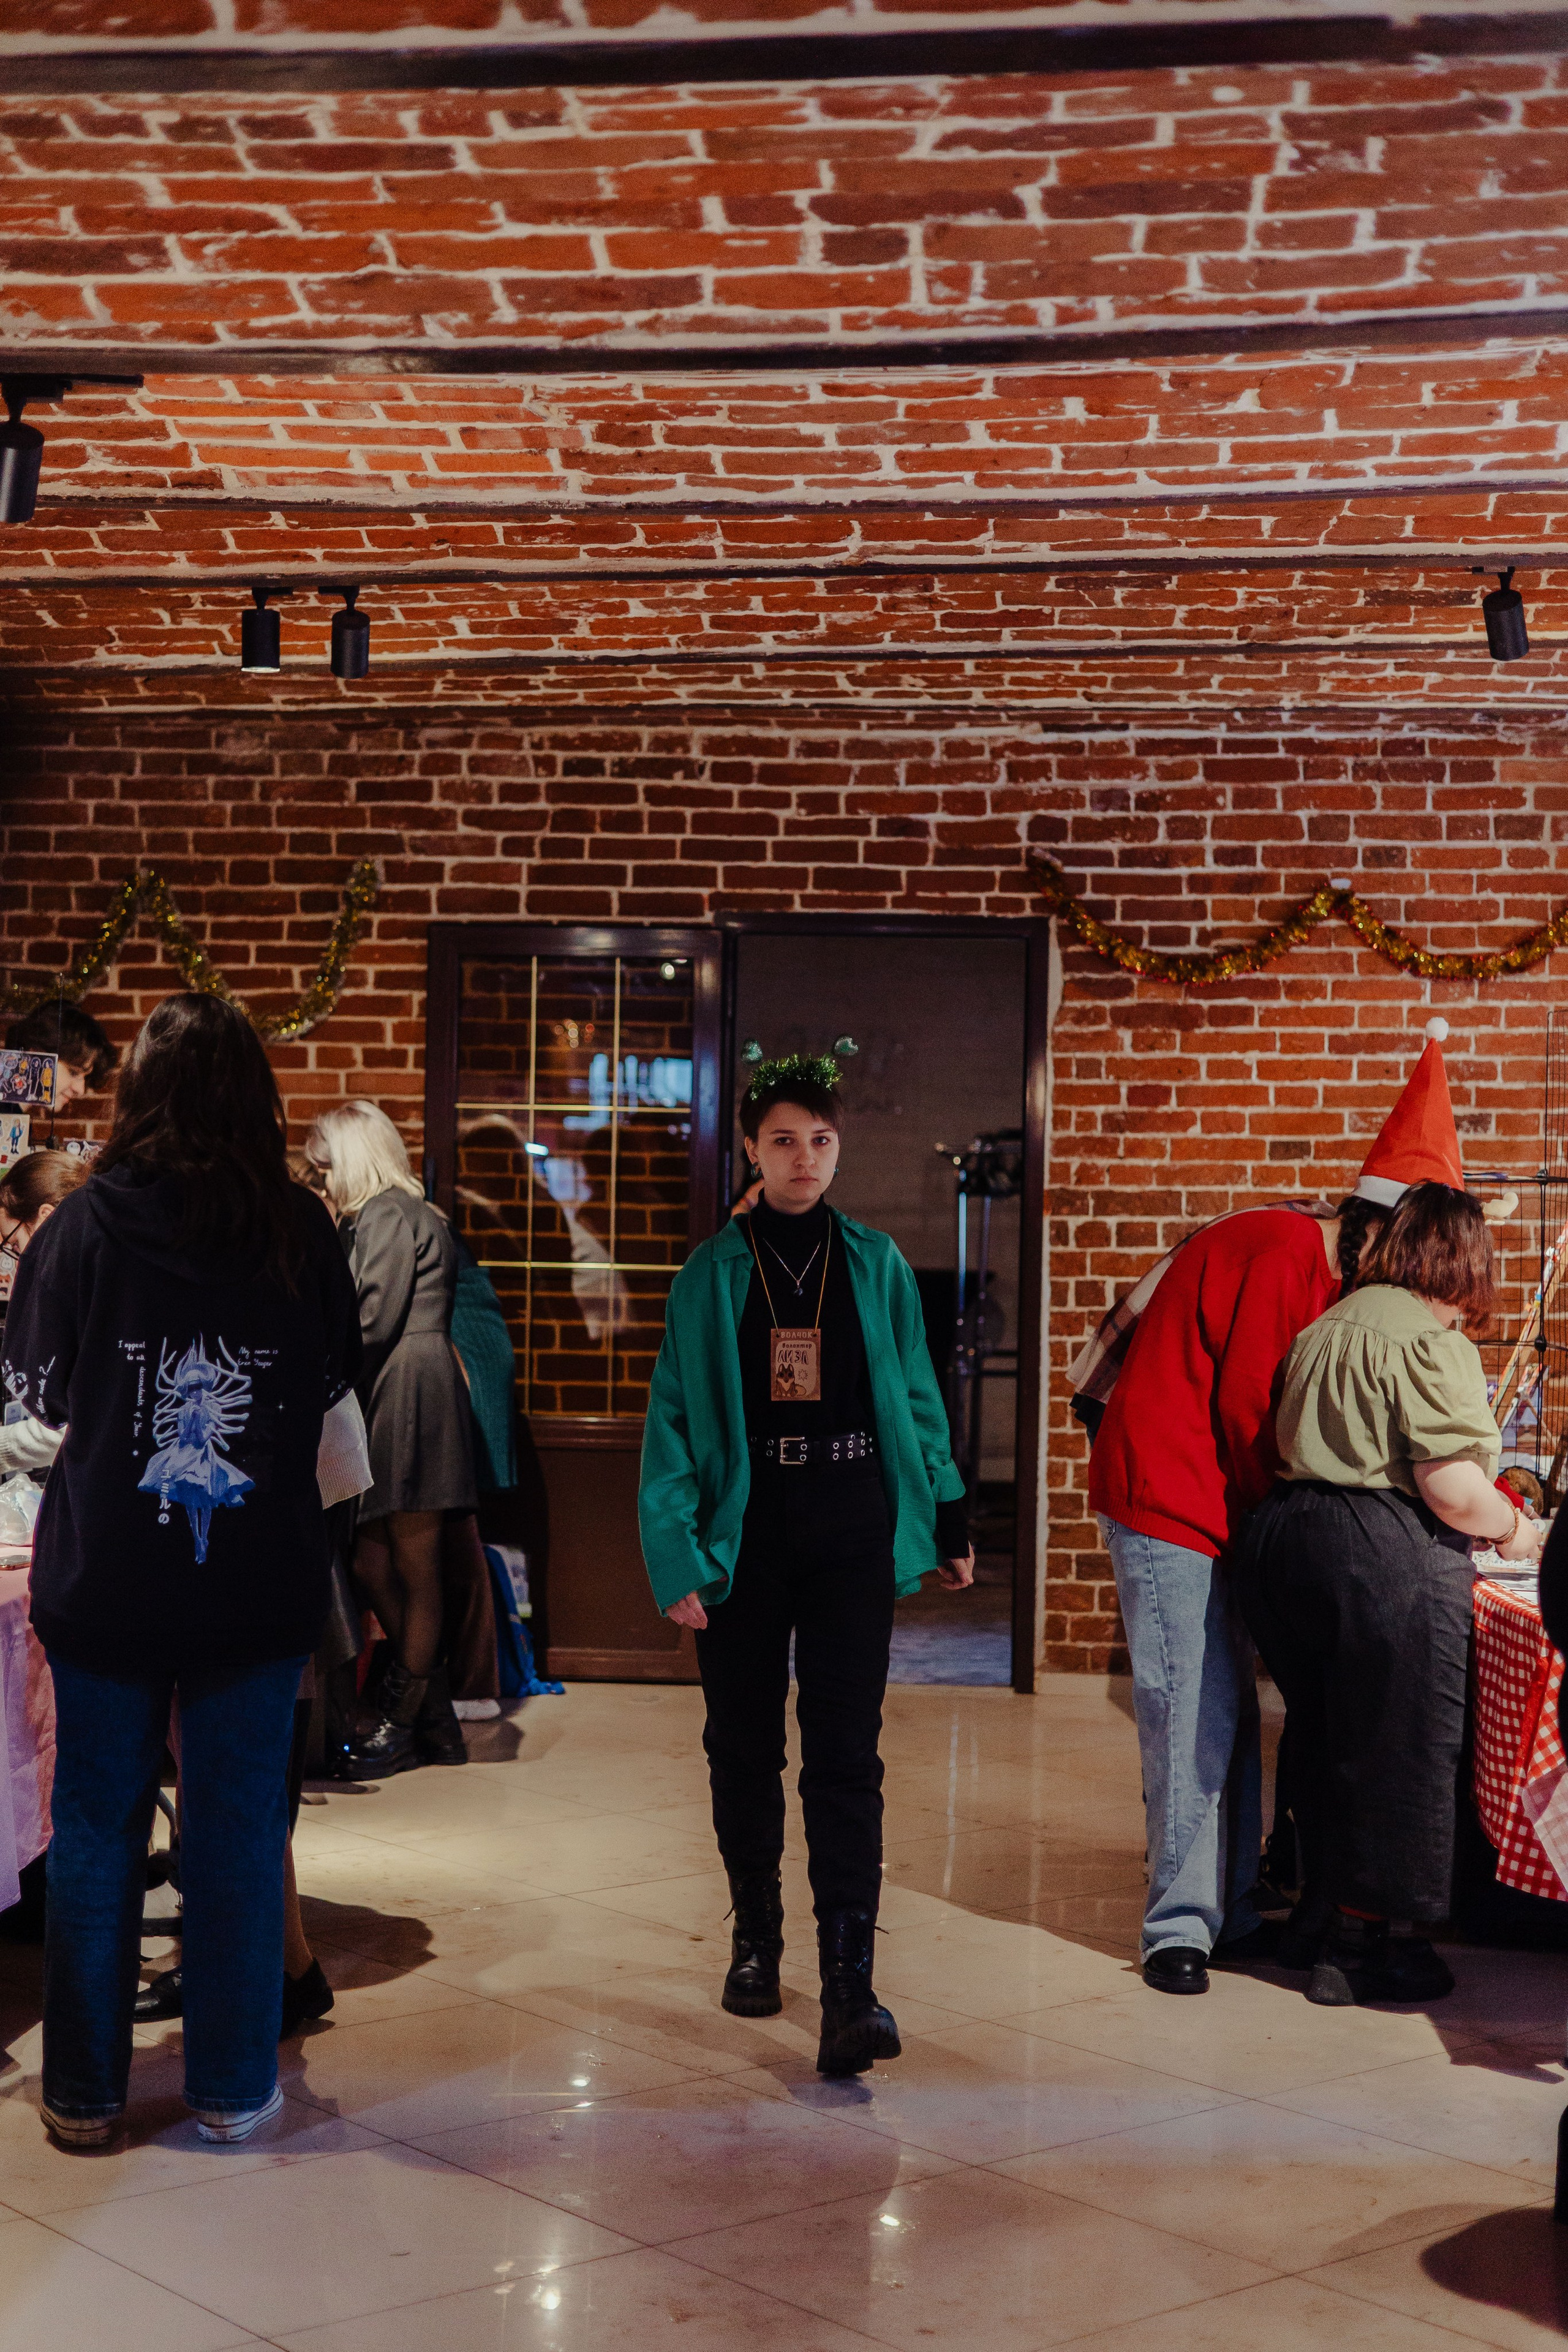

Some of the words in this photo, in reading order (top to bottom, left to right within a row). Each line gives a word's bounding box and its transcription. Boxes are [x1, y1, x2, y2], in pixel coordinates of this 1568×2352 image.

[124, 1341, 146, 1351] appeal
[238, 1346, 250, 1359] My
[137, 1366, 146, 1406] descendants
[158, 1469, 172, 1525] ユミルの
